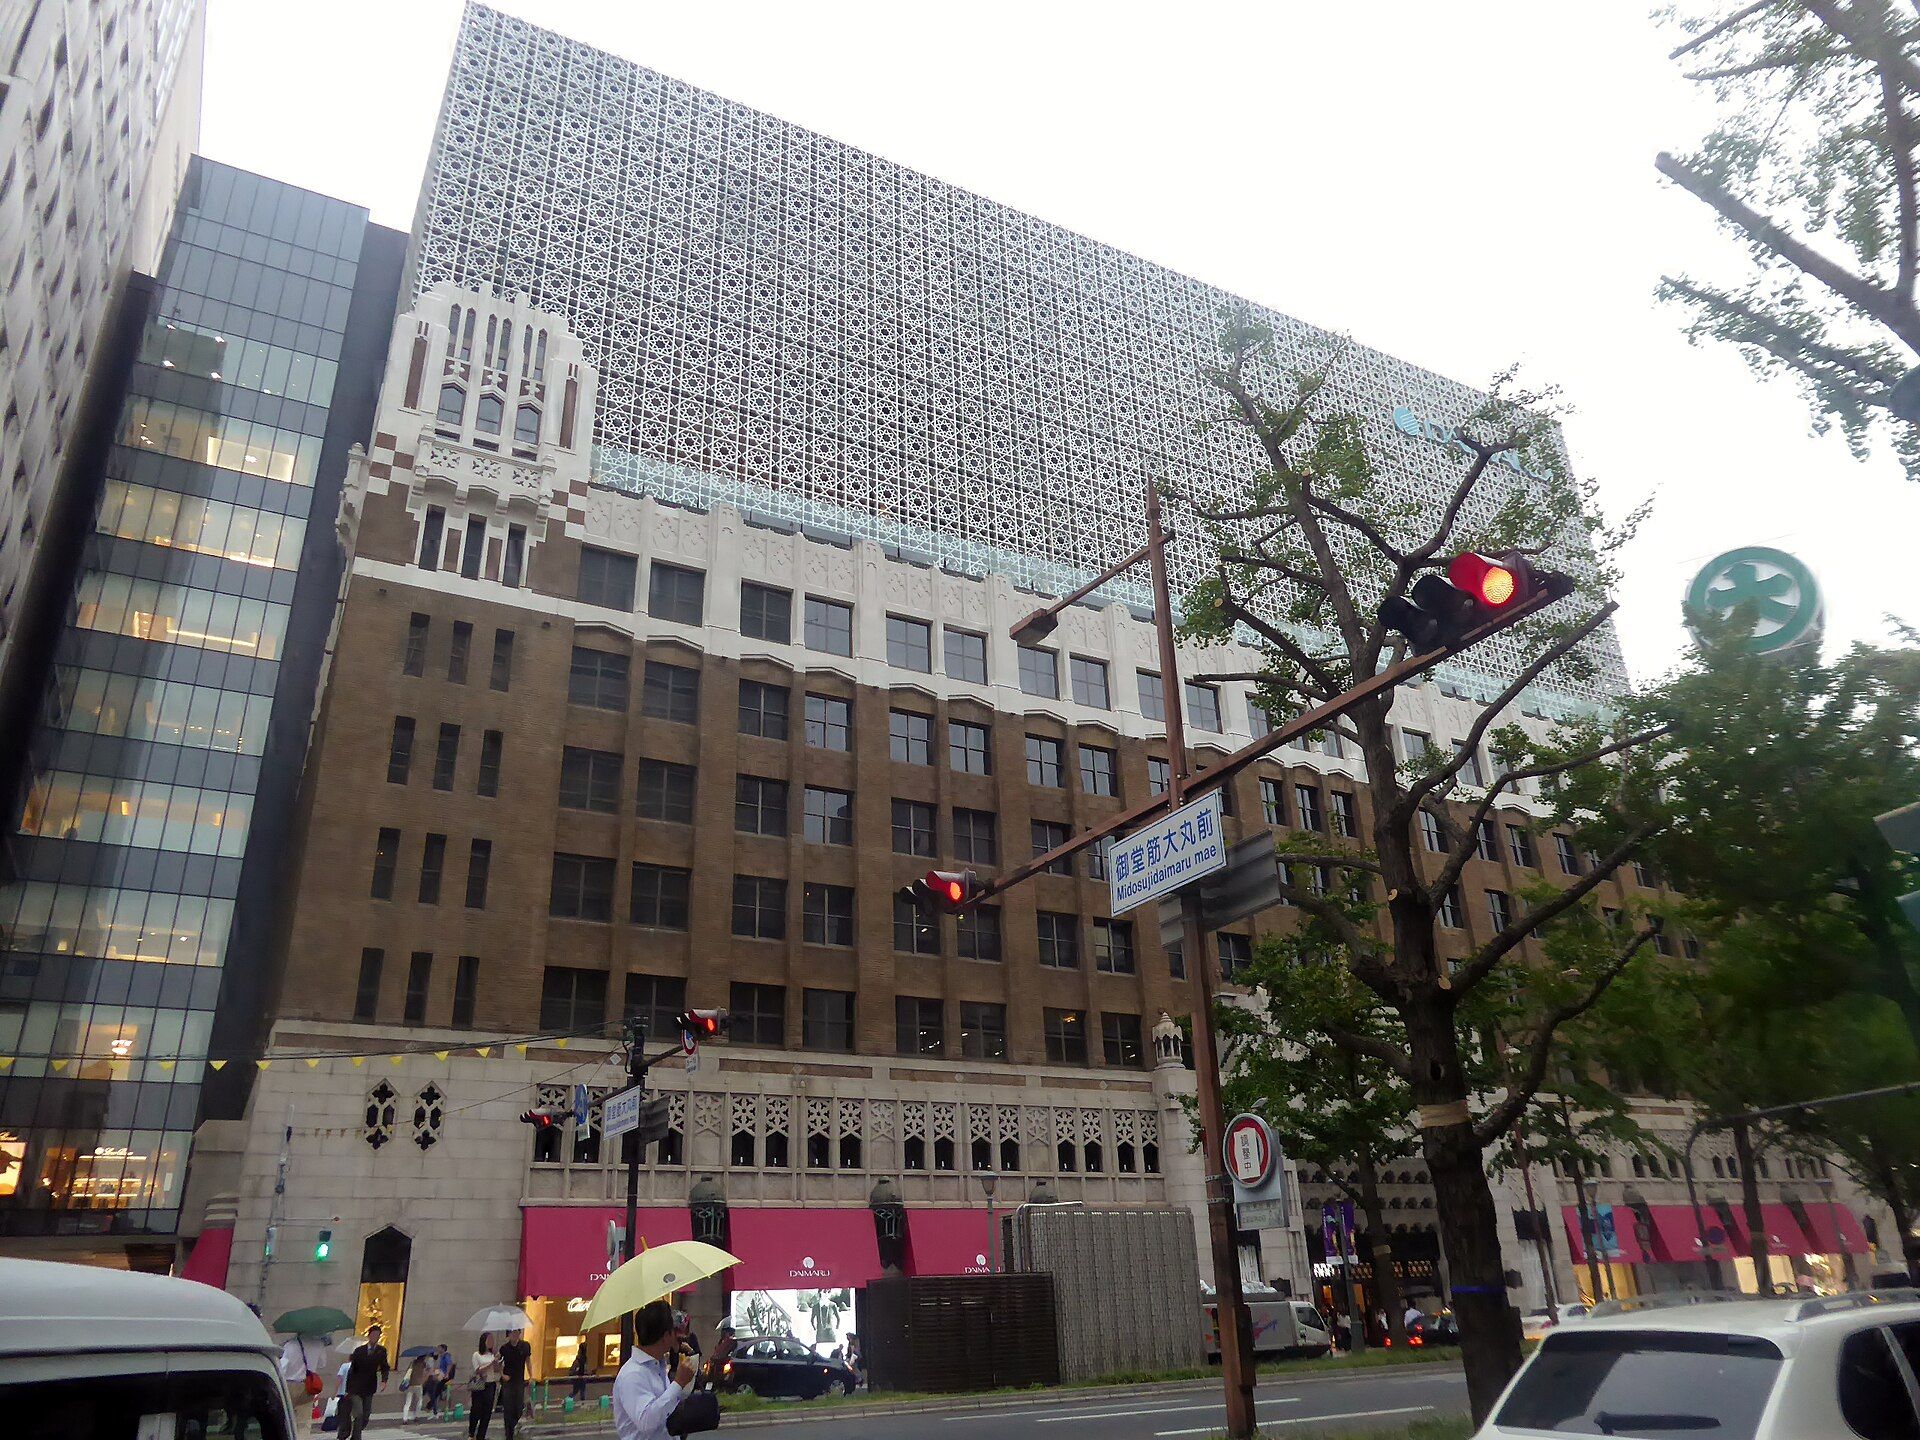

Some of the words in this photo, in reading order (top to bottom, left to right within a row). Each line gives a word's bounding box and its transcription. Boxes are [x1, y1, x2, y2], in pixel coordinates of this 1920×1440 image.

[1115, 808, 1214, 882] 御堂筋大丸前
[1117, 856, 1192, 901] Midosujidaimaru
[1194, 844, 1217, 865] mae
[789, 1269, 830, 1277] DAIMARU
